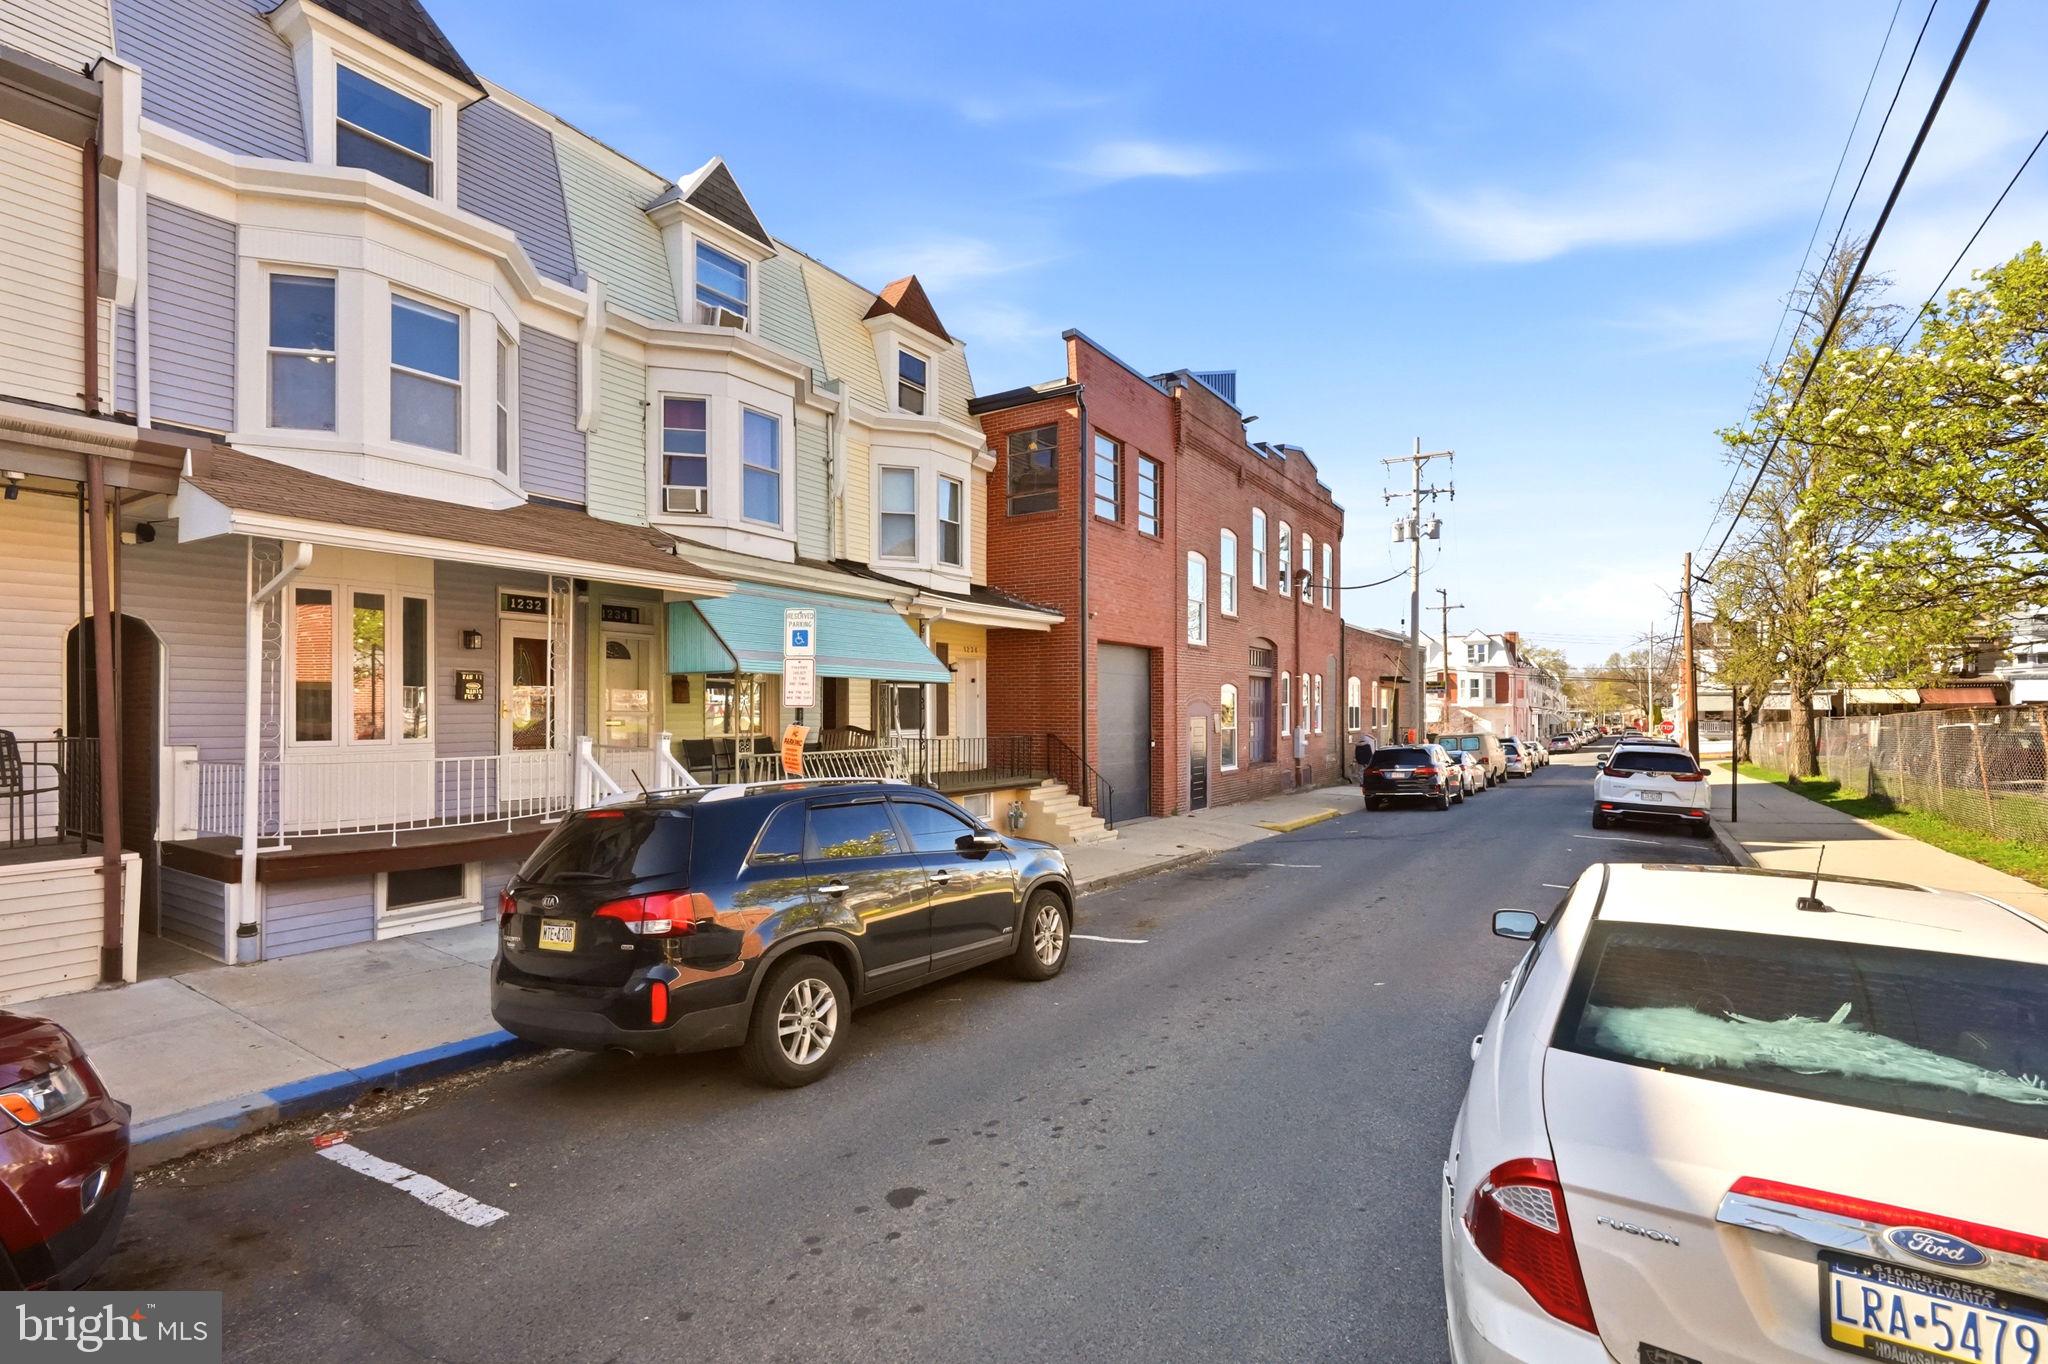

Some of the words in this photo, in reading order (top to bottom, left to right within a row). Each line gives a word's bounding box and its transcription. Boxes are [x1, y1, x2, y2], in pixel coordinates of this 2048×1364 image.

[511, 598, 542, 611] 1232
[787, 612, 814, 620] RESERVED
[1596, 1215, 1680, 1247] FUSION
[1907, 1232, 1966, 1261] Ford
[1877, 1272, 1993, 1309] PENNSYLVANIA
